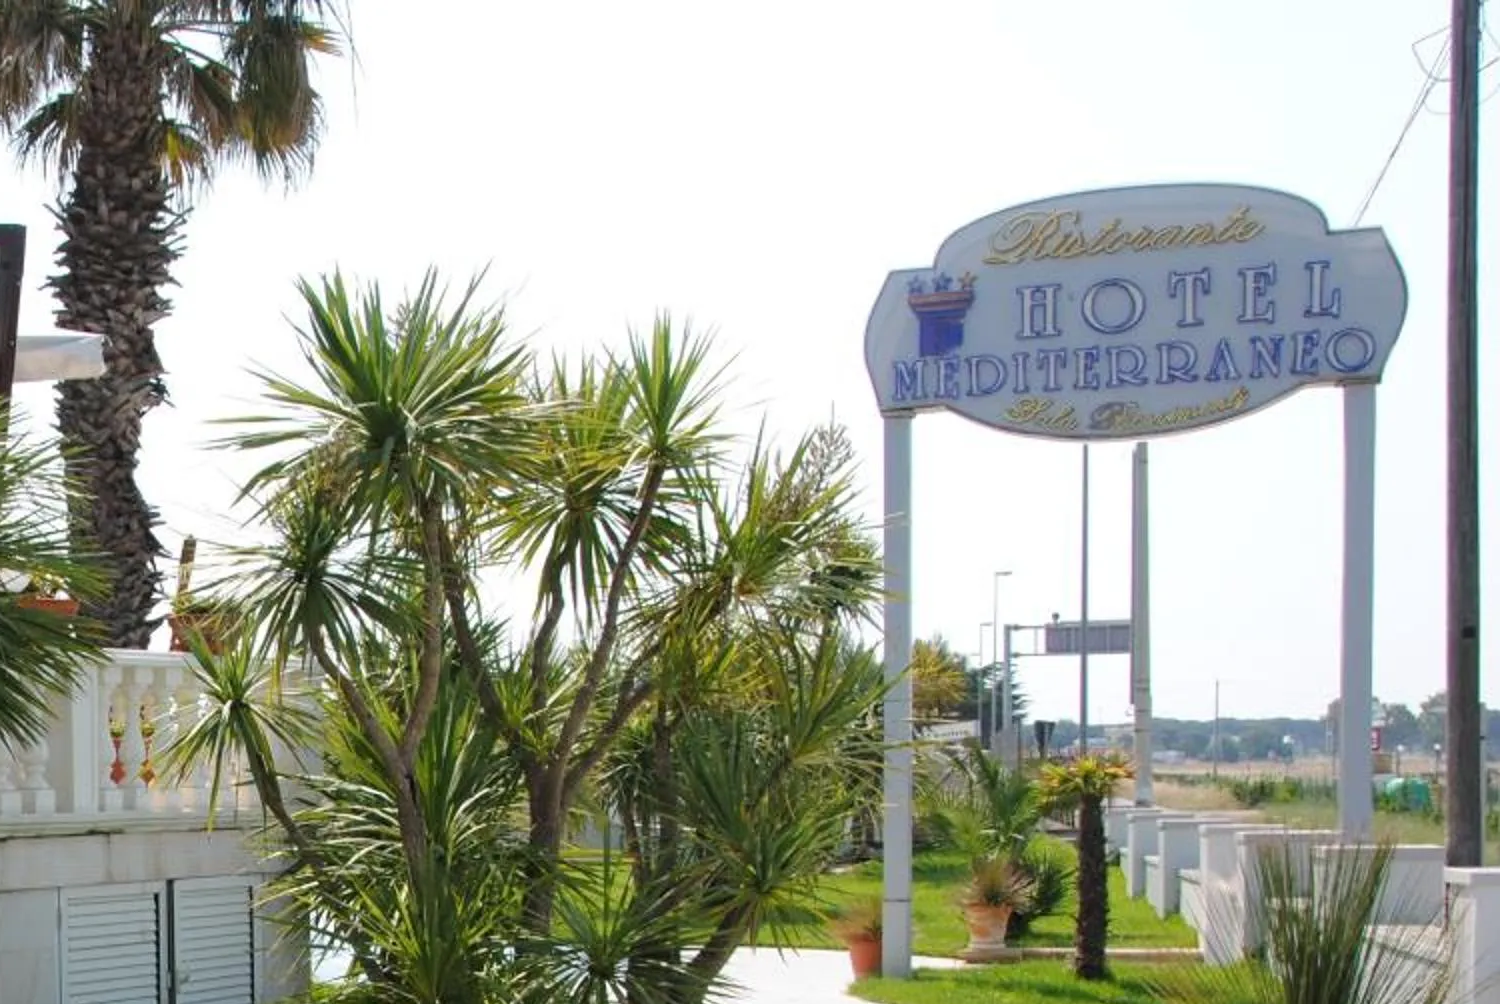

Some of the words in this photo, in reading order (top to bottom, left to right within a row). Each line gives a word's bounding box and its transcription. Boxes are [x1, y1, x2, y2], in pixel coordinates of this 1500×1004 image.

[982, 207, 1266, 264] Ristorante
[1016, 260, 1341, 340] HOTEL
[892, 328, 1376, 401] MEDITERRANEO
